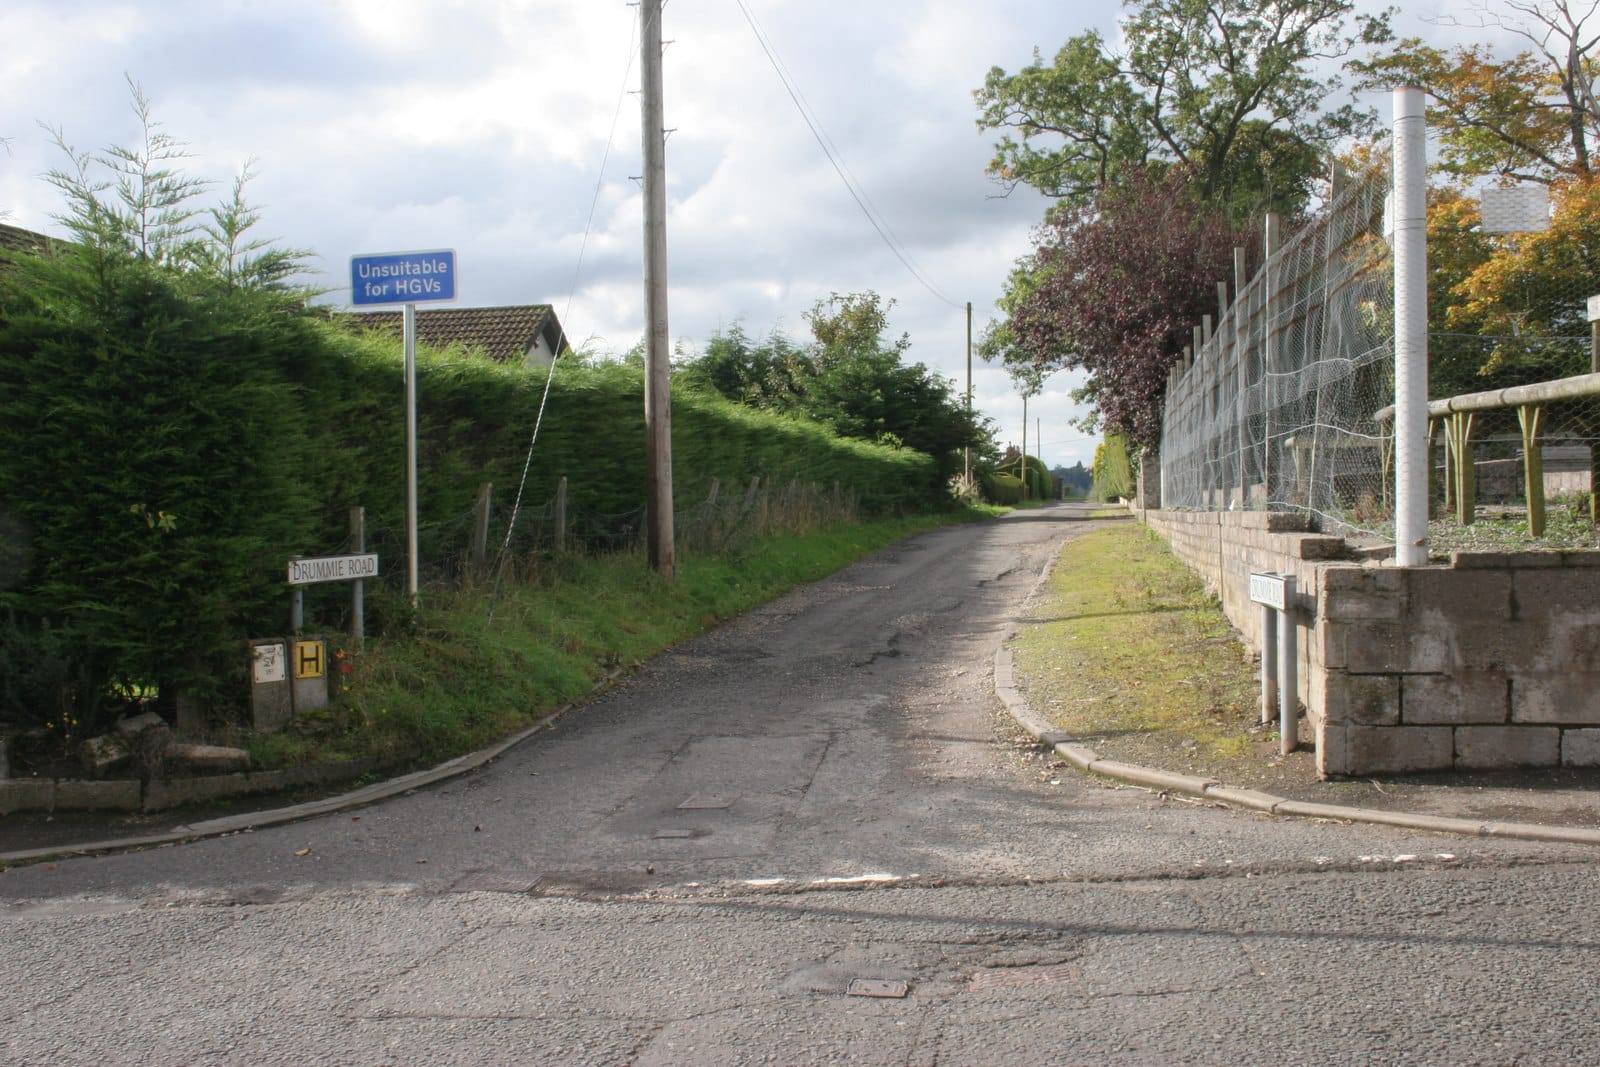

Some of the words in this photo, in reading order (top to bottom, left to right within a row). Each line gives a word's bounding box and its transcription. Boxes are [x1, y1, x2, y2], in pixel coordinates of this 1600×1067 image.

[359, 259, 447, 278] Unsuitable
[364, 282, 389, 297] for
[396, 278, 440, 294] HGVs
[293, 561, 344, 580] DRUMMIE
[348, 558, 374, 575] ROAD
[301, 645, 319, 674] H
